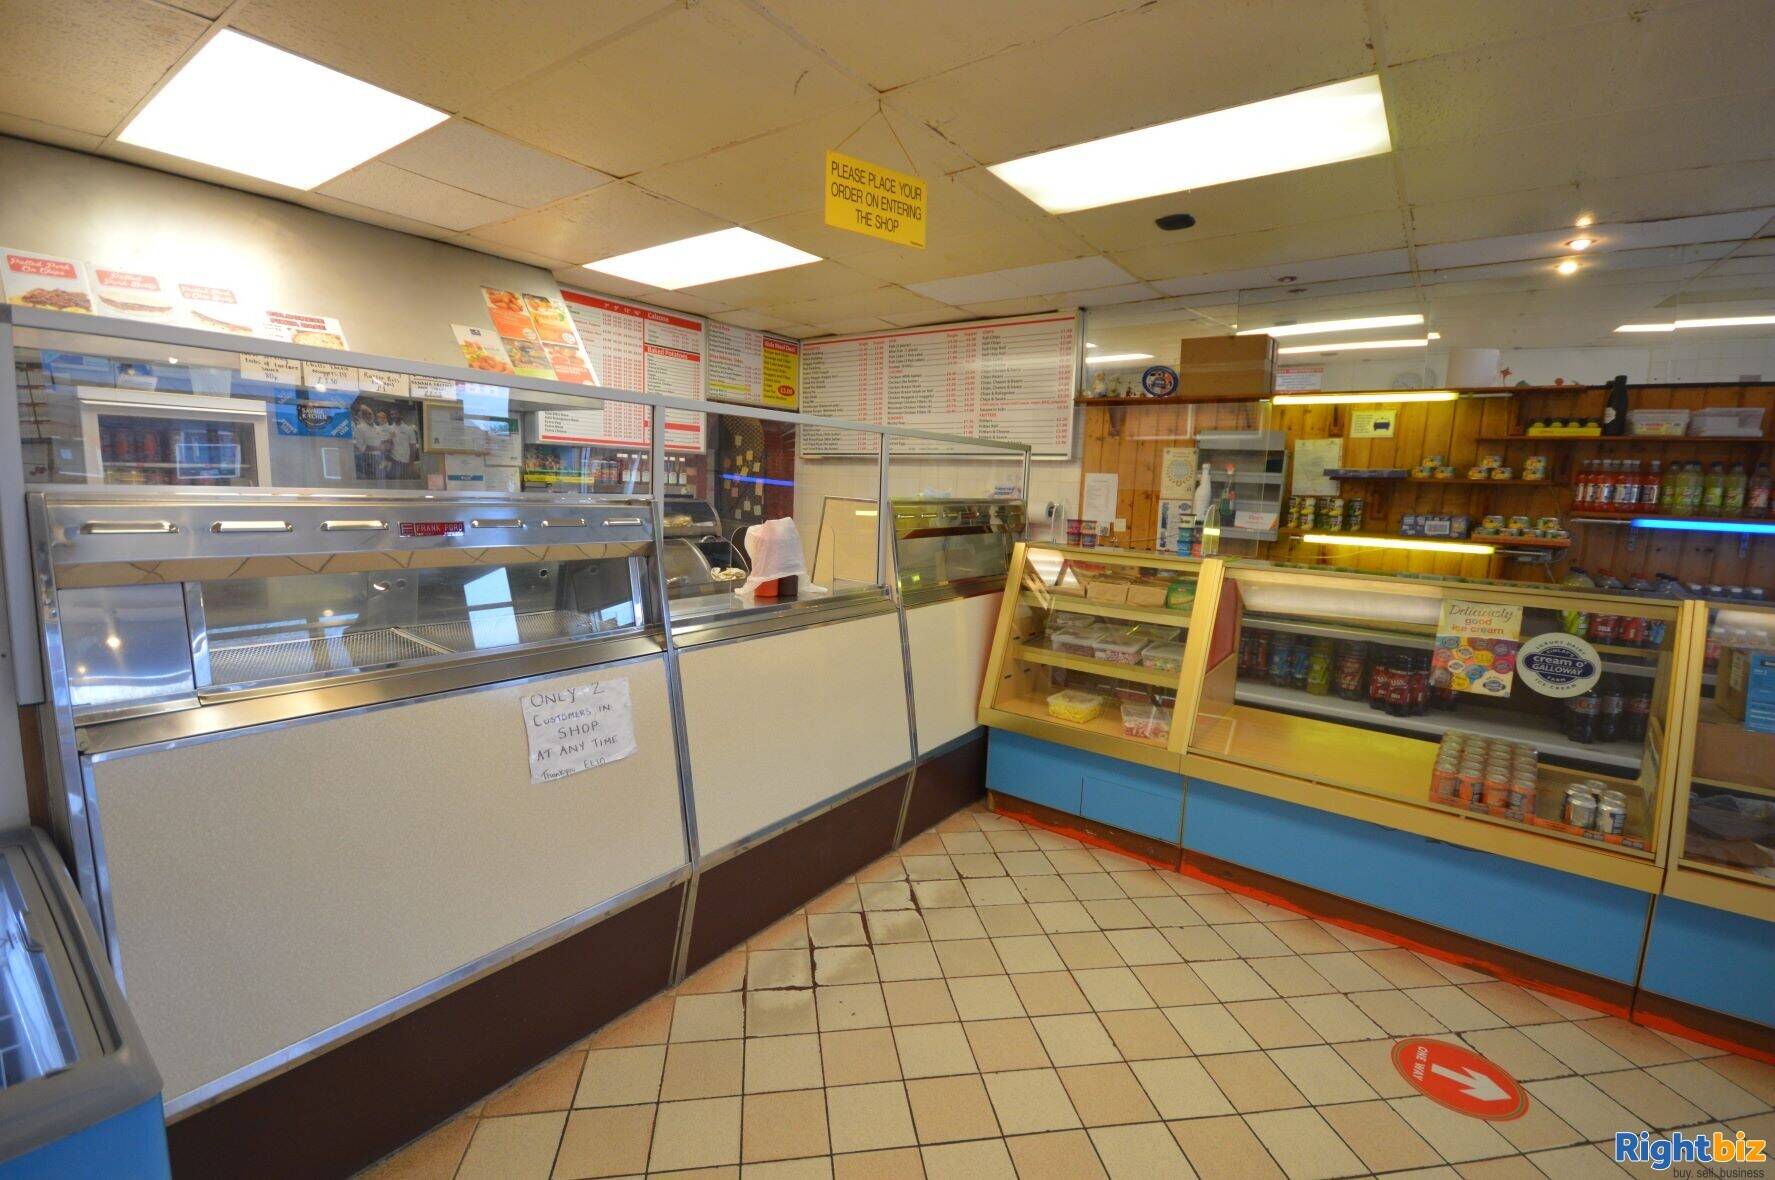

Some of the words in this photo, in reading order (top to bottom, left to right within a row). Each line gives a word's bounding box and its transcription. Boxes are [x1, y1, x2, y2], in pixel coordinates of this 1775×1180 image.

[832, 161, 866, 184] PLEASE
[868, 172, 896, 194] PLACE
[899, 182, 922, 202] YOUR
[830, 182, 863, 203] ORDER
[866, 192, 879, 208] ON
[881, 196, 922, 220] ENTERING
[856, 208, 872, 226] THE
[875, 214, 900, 232] SHOP
[444, 524, 463, 532] FORD
[1448, 604, 1514, 623] Deliciously
[1465, 618, 1492, 626] good
[1532, 656, 1572, 666] cream
[1532, 663, 1582, 676] GALLOWAY
[530, 688, 576, 707] ONLY
[591, 682, 605, 694] 2
[599, 704, 610, 712] IN
[558, 721, 600, 739] SHOP
[537, 748, 552, 761] AT
[560, 740, 585, 756] ANY
[592, 735, 618, 748] TIME
[1416, 1046, 1428, 1061] ONE
[1412, 1062, 1425, 1082] WAY
